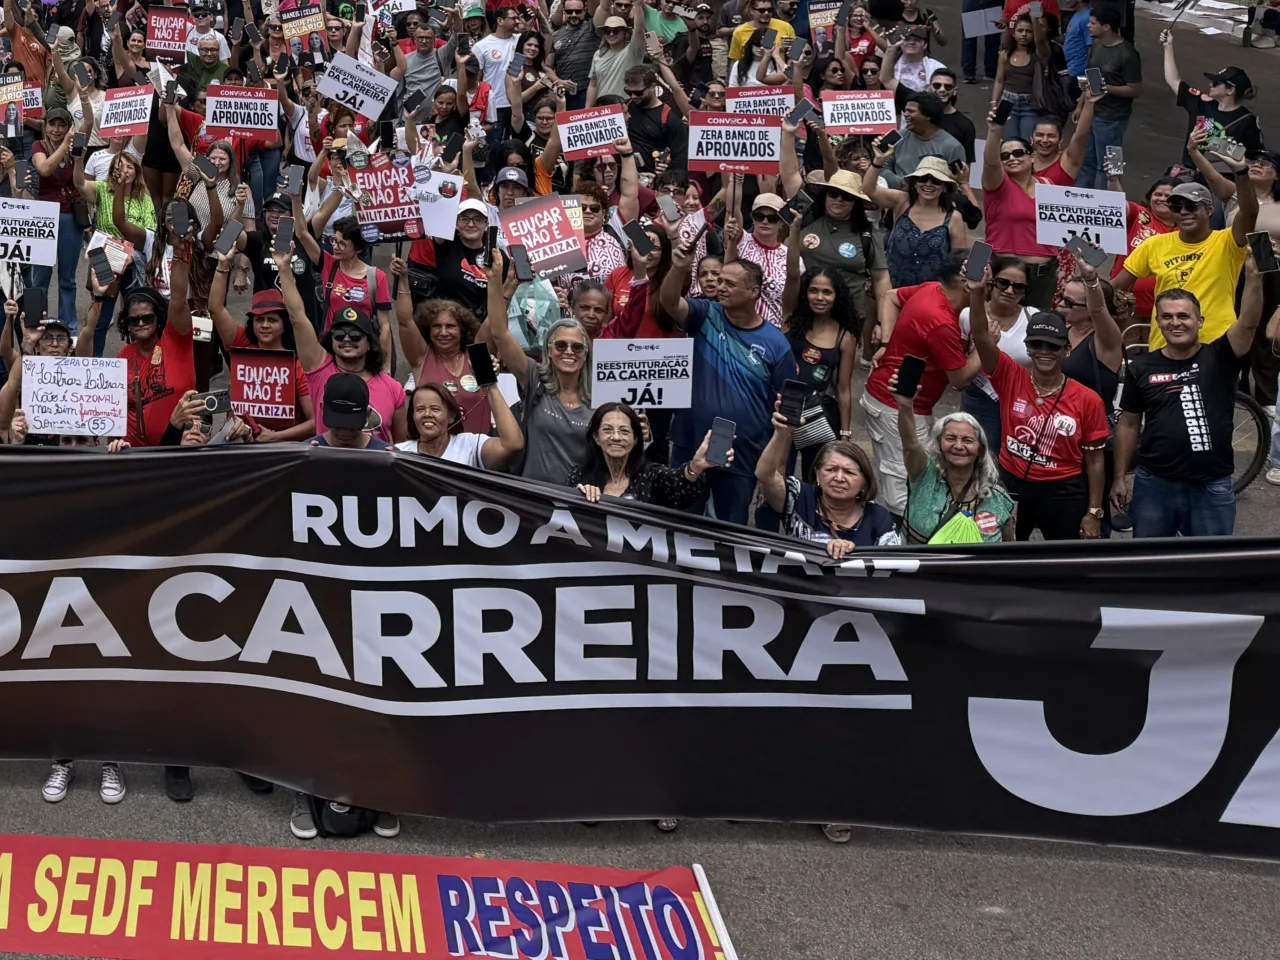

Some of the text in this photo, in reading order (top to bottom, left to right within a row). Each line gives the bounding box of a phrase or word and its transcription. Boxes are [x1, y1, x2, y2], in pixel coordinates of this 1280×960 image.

[151, 16, 184, 29] EDUCAR
[154, 29, 172, 39] NÃO
[147, 41, 186, 50] MILITARIZAR
[331, 65, 389, 97] REESTRUTURAÇÃO
[341, 77, 386, 104] CARREIRA
[139, 98, 146, 107] DE
[215, 101, 269, 111] ZERA BANCO DE
[335, 90, 364, 111] JÁ!
[734, 98, 786, 109] ZERA BANCO DE
[851, 102, 875, 110] BANCO
[104, 107, 148, 125] APROVADOS
[212, 111, 273, 126] APROVADOS
[830, 110, 892, 123] APROVADOS
[567, 118, 617, 134] ZERA BANCO DE
[567, 126, 624, 148] APROVADOS
[700, 130, 769, 140] ZERA BANCO DE
[696, 141, 775, 157] APROVADOS
[356, 167, 409, 190] EDUCAR
[1038, 204, 1122, 218] REESTRUTURAÇÃO
[509, 207, 563, 236] EDUCAR
[1039, 212, 1124, 228] DA CARREIRA
[521, 227, 551, 250] NÃO
[54, 357, 121, 368] ZERA O BANCO
[596, 359, 689, 370] REESTRUTURAÇÃO
[236, 364, 290, 384] EDUCAR
[597, 368, 690, 381] DA CARREIRA
[32, 388, 58, 403] Não
[70, 392, 120, 406] SAZONAL,
[243, 383, 283, 402] NÃO É
[621, 383, 663, 406] JÁ!
[233, 402, 294, 418] MILITARIZAR
[92, 419, 106, 430] 55
[292, 492, 520, 551] RUMO
[146, 570, 910, 690] CARREIRA
[27, 853, 158, 937] SEDF
[172, 859, 426, 954] MERECEM
